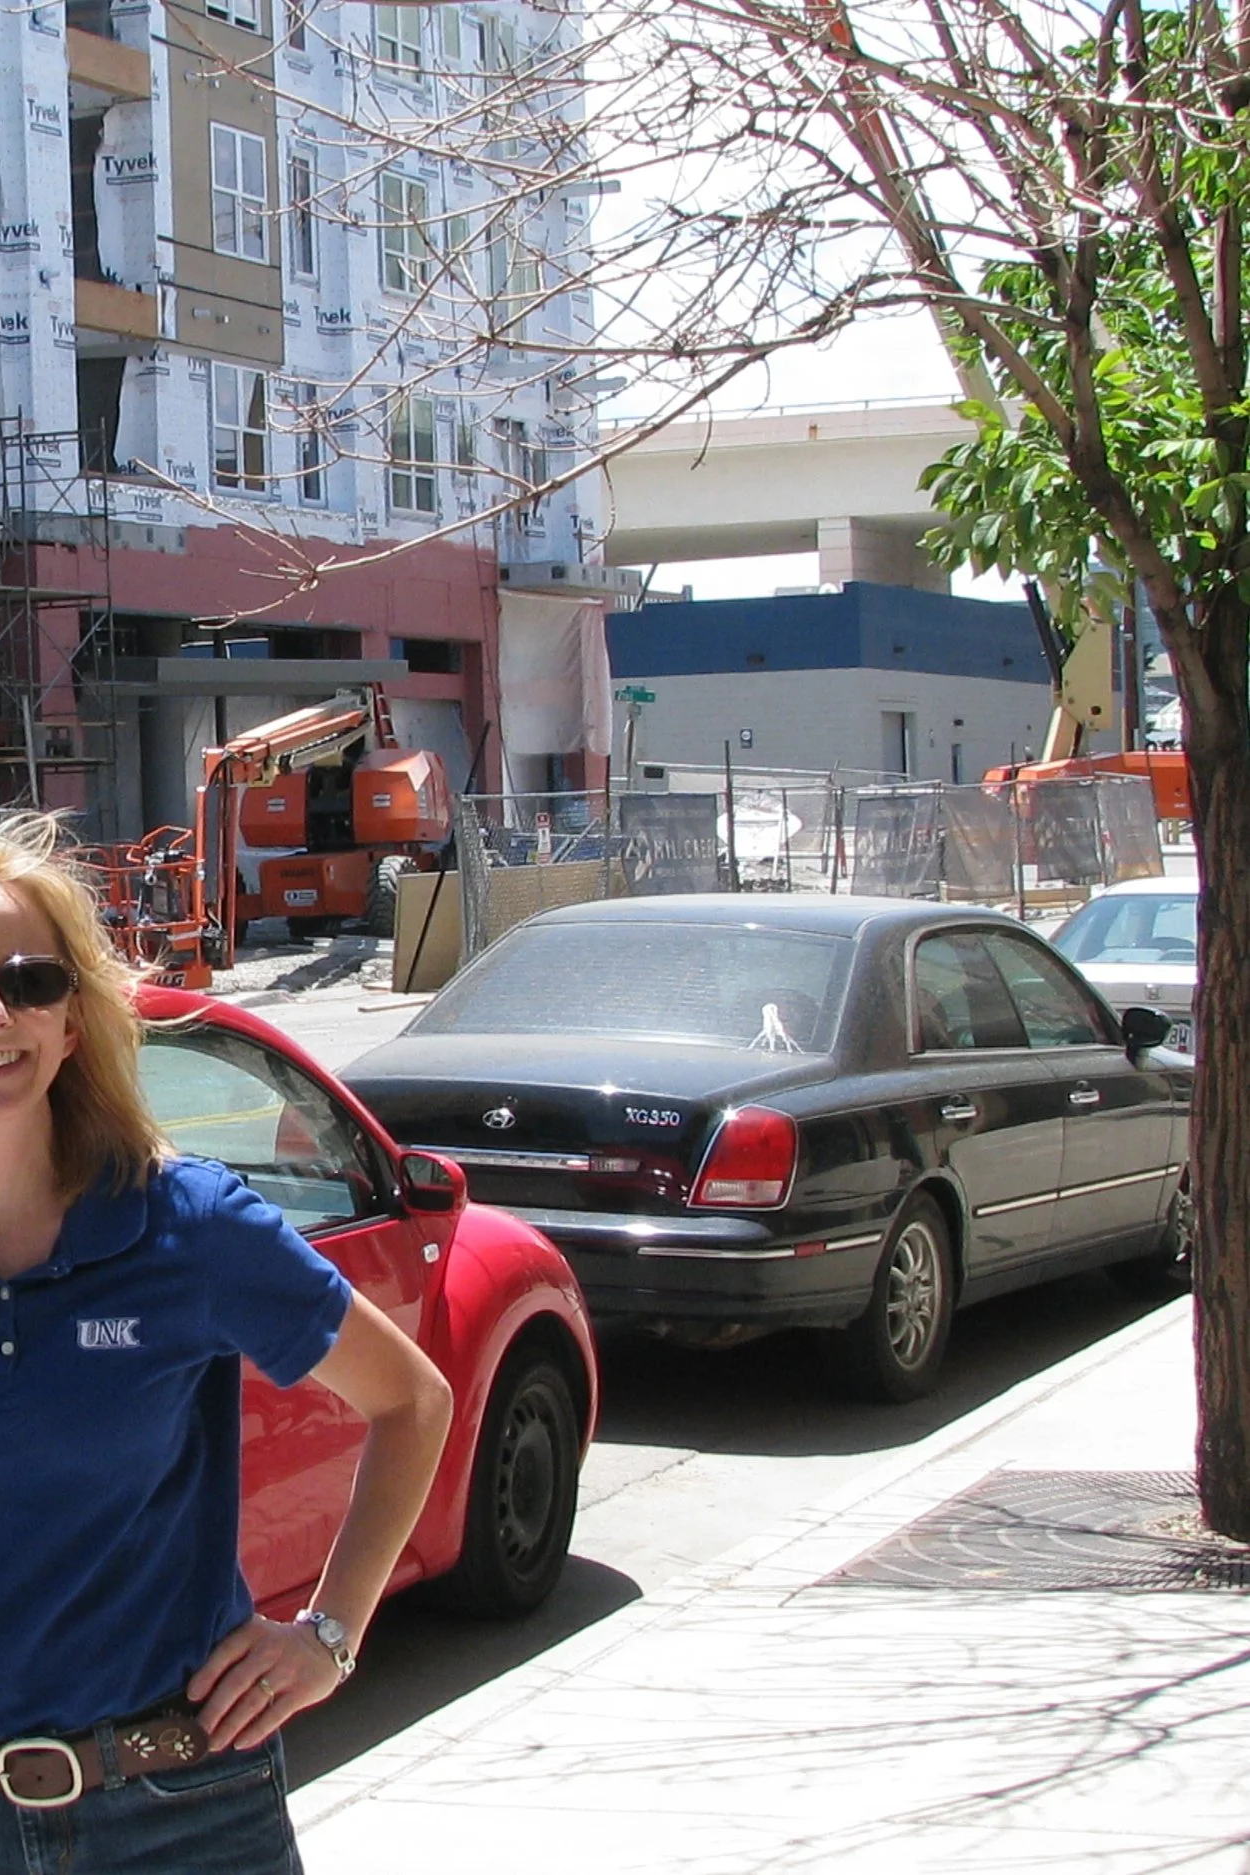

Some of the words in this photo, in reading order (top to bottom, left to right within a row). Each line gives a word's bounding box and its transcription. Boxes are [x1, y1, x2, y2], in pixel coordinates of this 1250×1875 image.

[27, 98, 61, 123] Tyvek
[102, 152, 158, 176] Tyvek
[166, 458, 196, 481] Tyvek
[624, 1105, 681, 1128] XG350
[77, 1317, 141, 1349] UNK
